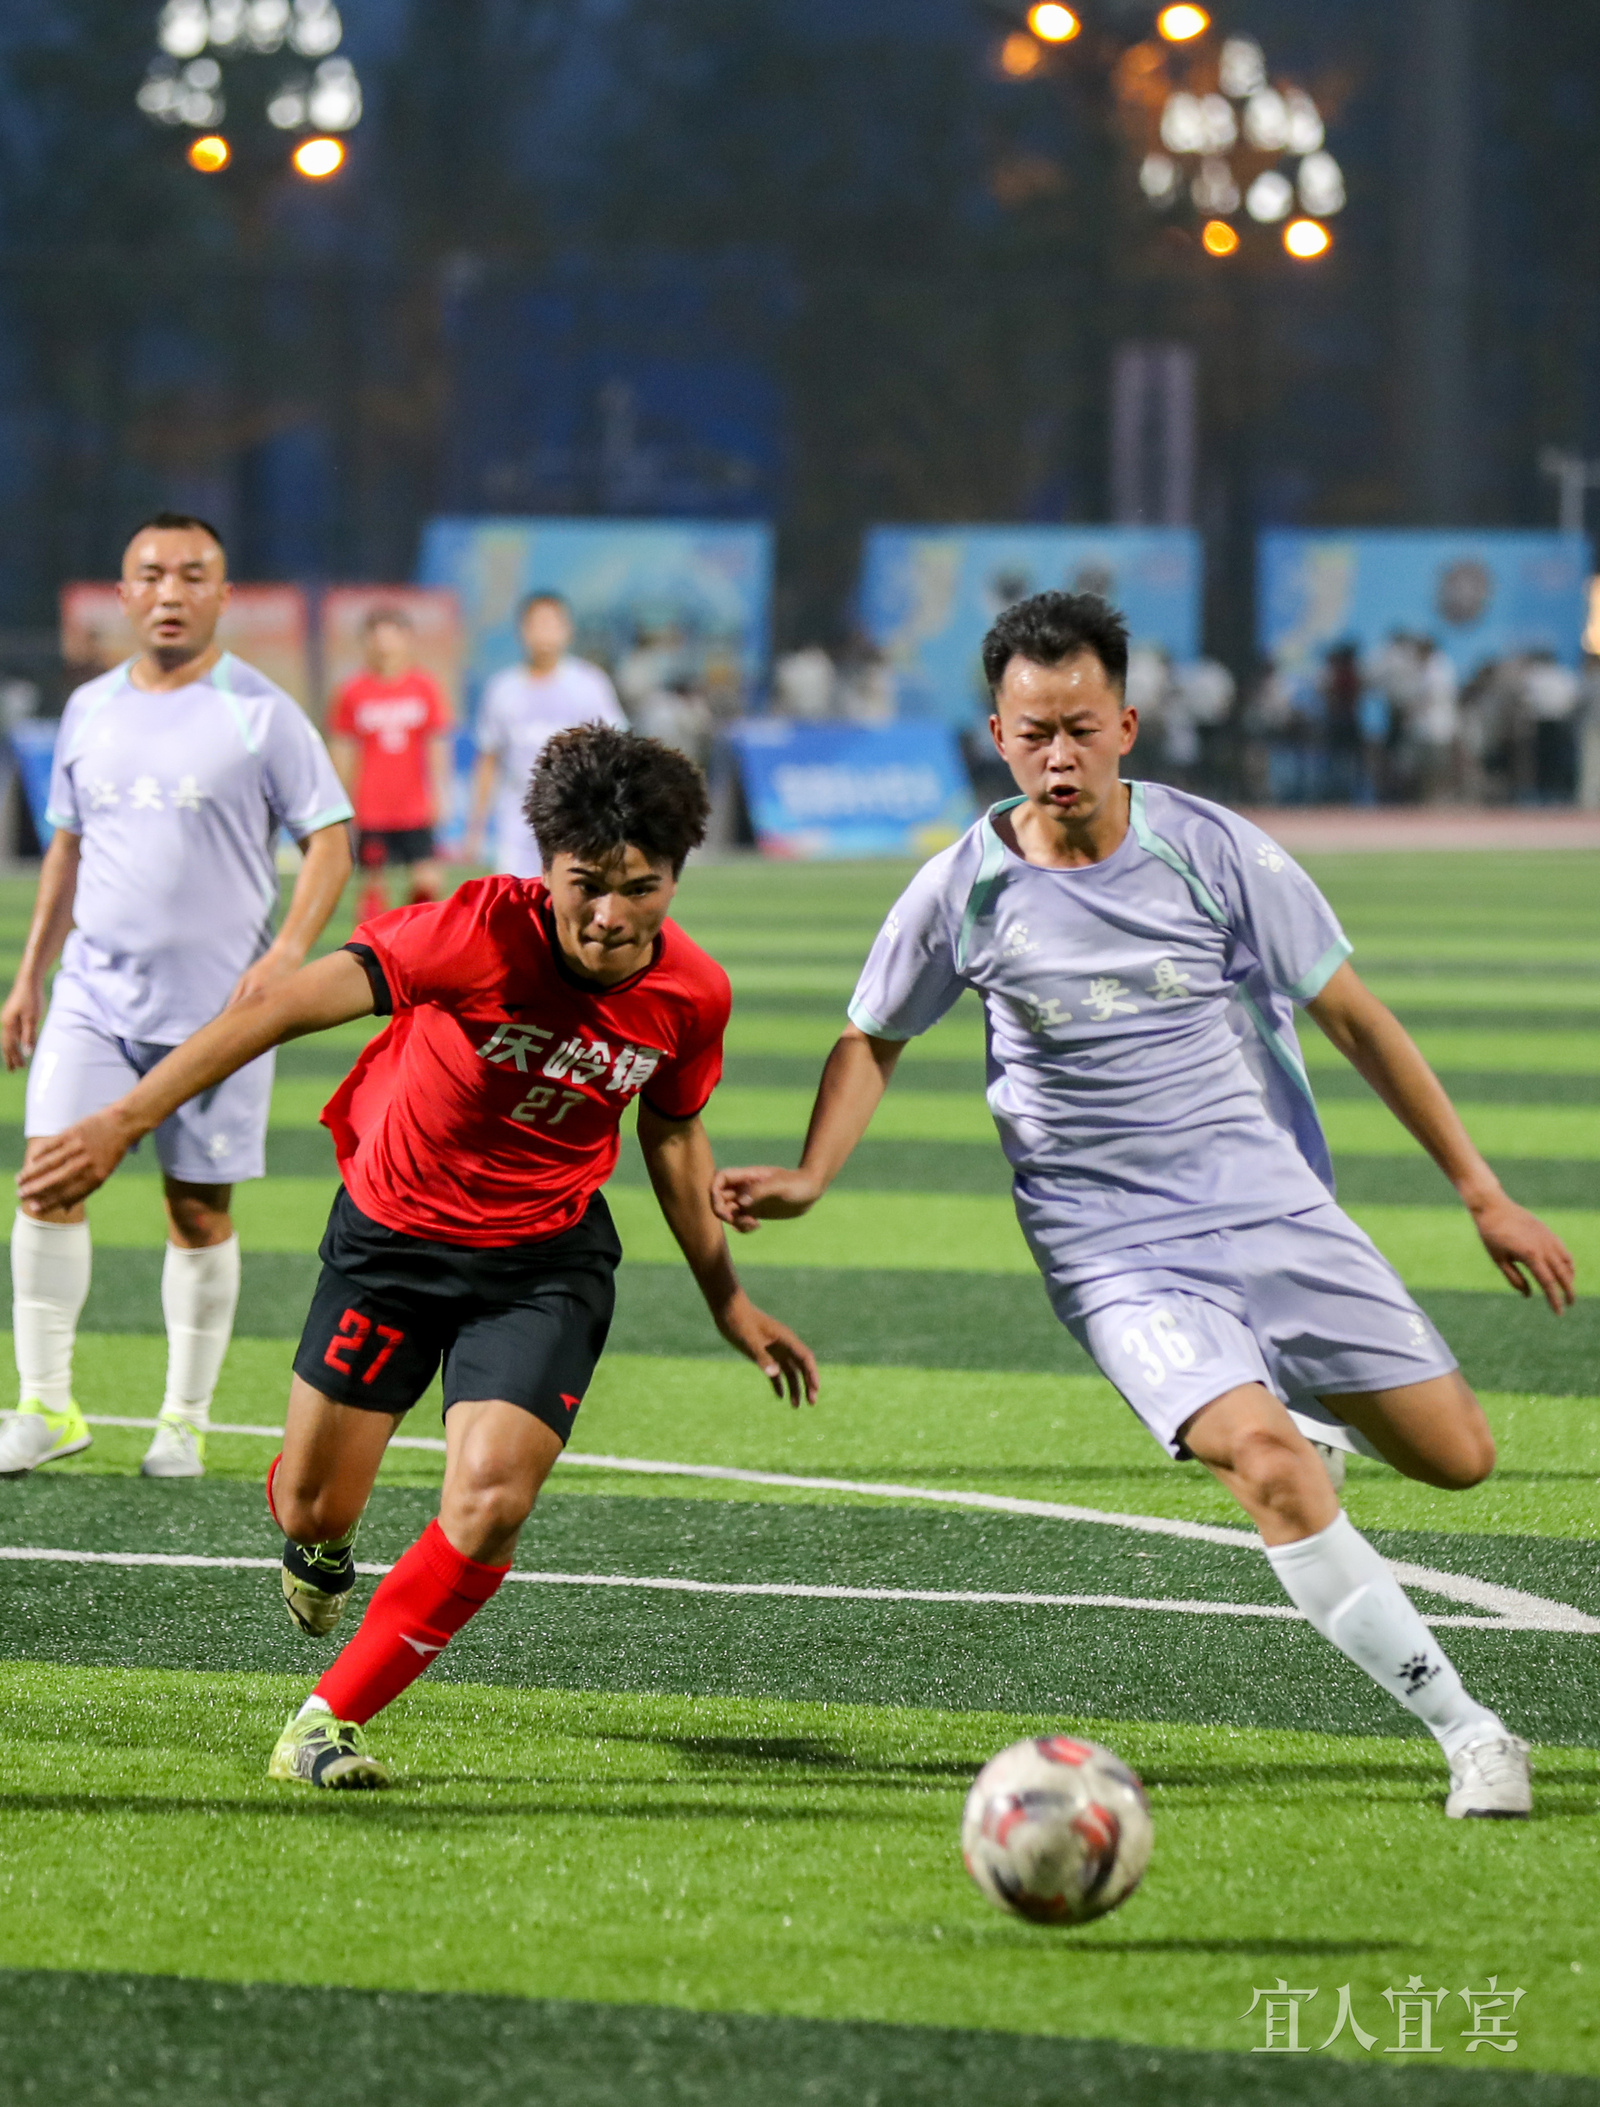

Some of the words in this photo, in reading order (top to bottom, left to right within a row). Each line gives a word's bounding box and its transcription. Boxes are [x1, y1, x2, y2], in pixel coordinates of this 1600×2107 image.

[1027, 958, 1191, 1033] 江安县
[475, 1023, 668, 1093] 庆岭镇
[511, 1085, 588, 1125] 27
[324, 1308, 405, 1385] 27
[1121, 1309, 1196, 1387] 36
